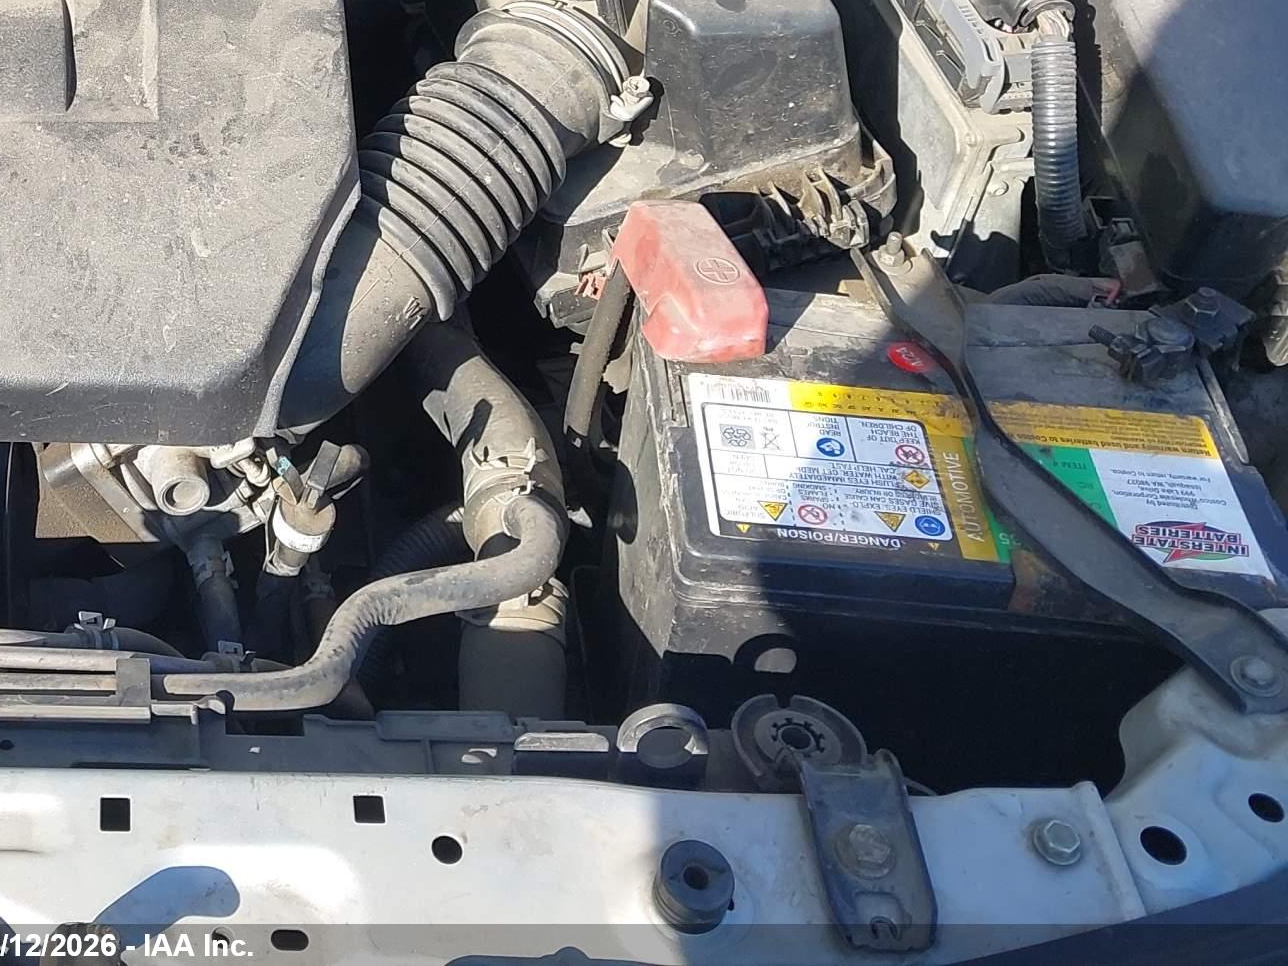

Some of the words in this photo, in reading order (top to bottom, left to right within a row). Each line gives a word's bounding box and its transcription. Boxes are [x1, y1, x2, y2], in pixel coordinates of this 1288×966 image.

[1060, 437, 1100, 446] batteries
[943, 452, 984, 542] AUTOMOTIVE
[777, 528, 902, 548] DANGER/POISON
[1138, 525, 1239, 543] BATTERIES
[1134, 536, 1247, 555] INTERSTATE
